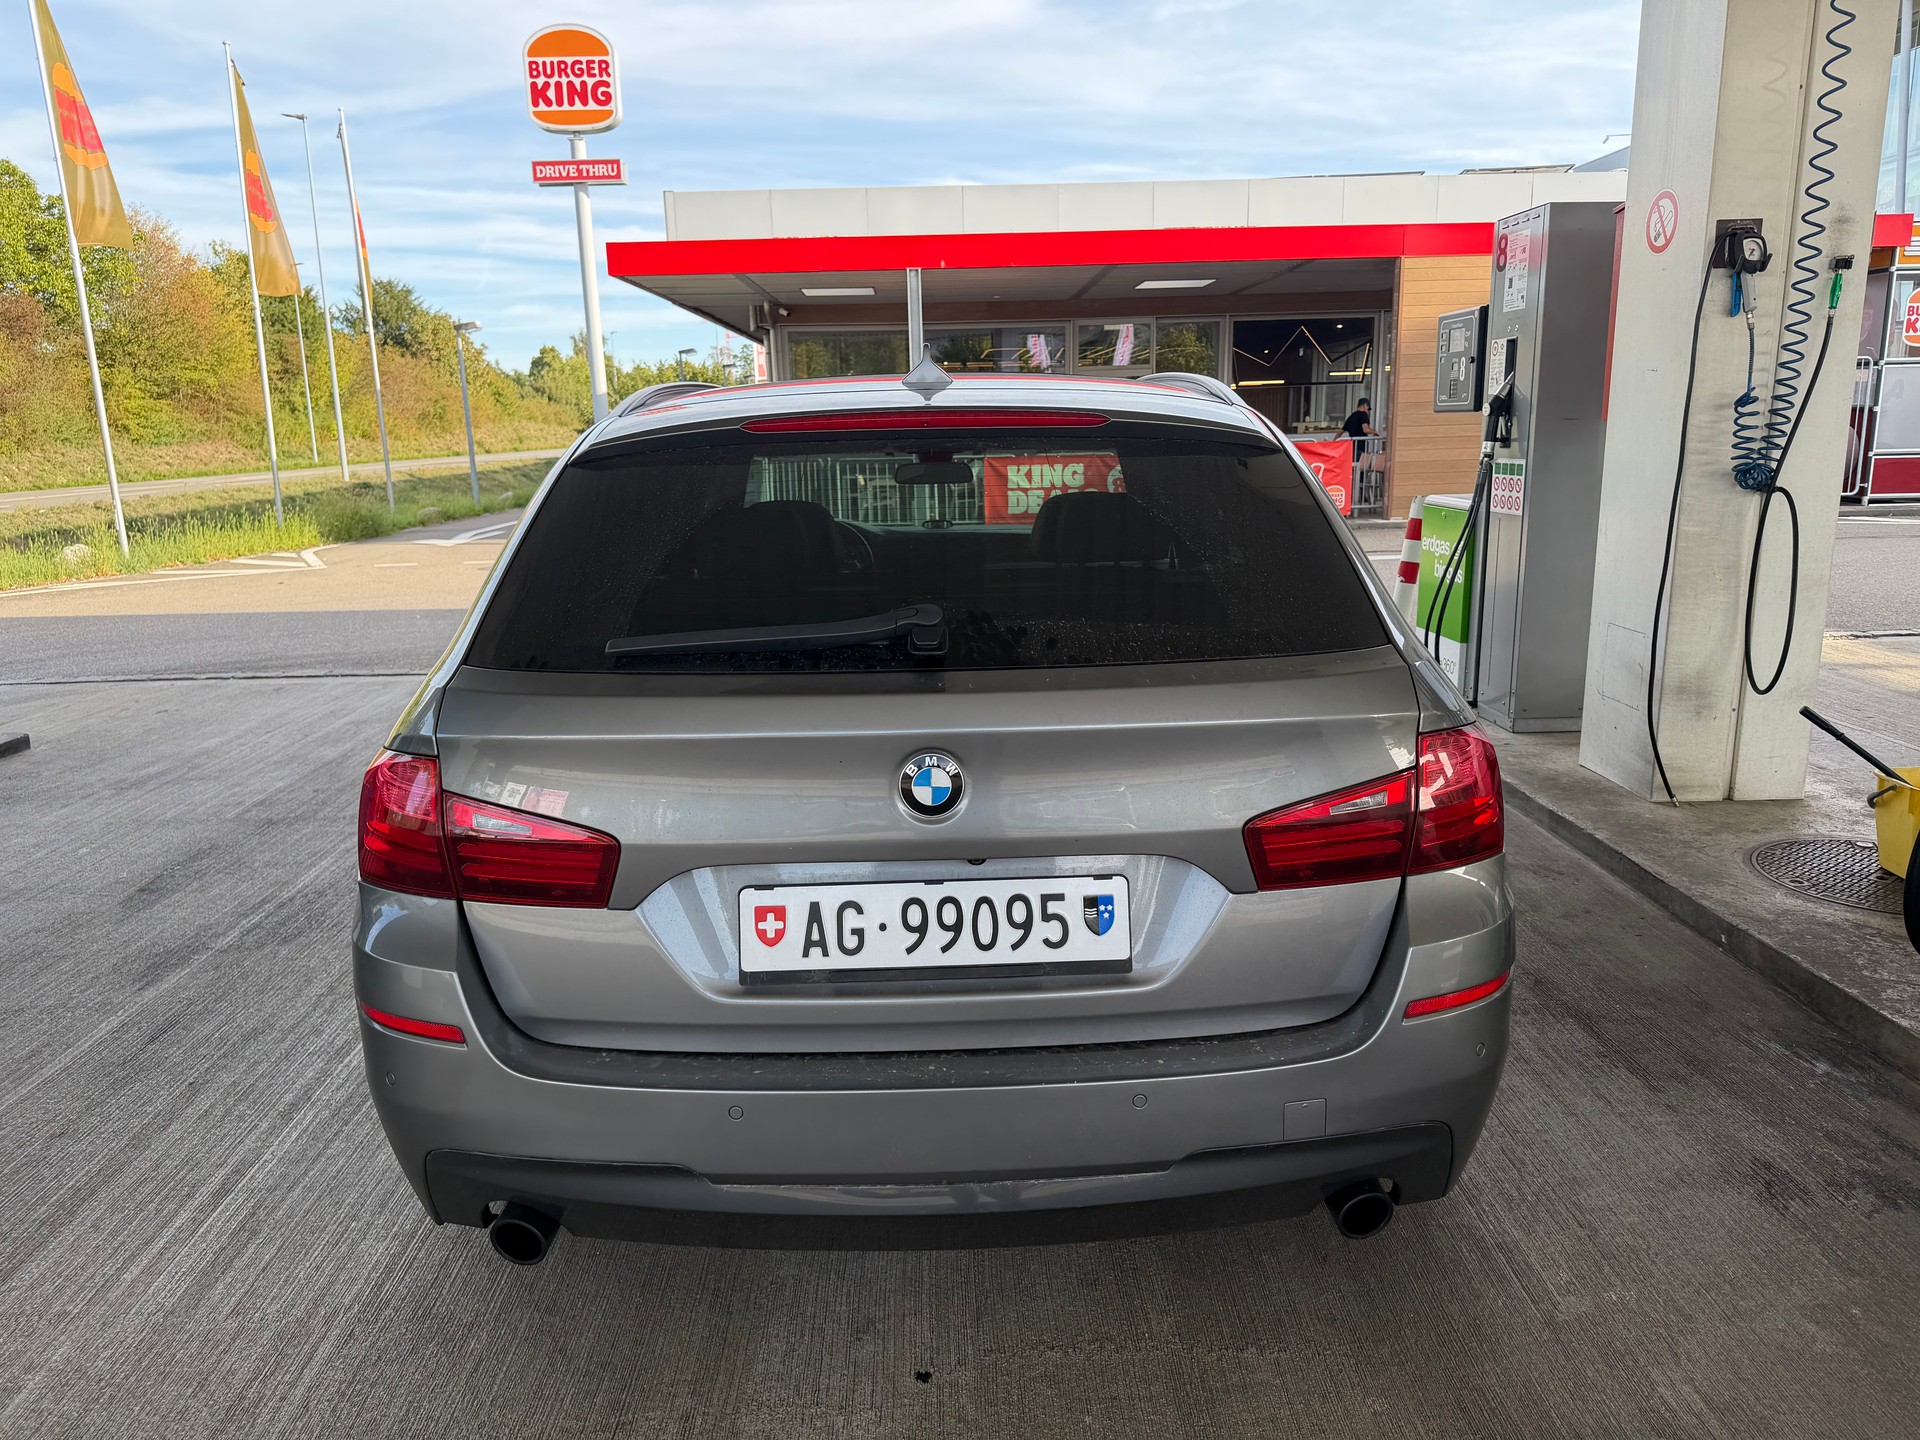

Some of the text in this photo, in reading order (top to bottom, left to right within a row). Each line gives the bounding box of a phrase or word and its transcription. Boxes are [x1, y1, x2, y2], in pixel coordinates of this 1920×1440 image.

[528, 59, 612, 79] BURGER
[530, 80, 613, 108] KING
[535, 164, 618, 178] DRIVE THRU
[1496, 233, 1509, 273] 8
[1459, 356, 1467, 381] 8
[1007, 463, 1085, 488] KING
[1422, 535, 1450, 557] erdgas
[1434, 559, 1463, 584] bigs
[905, 756, 959, 778] BMW
